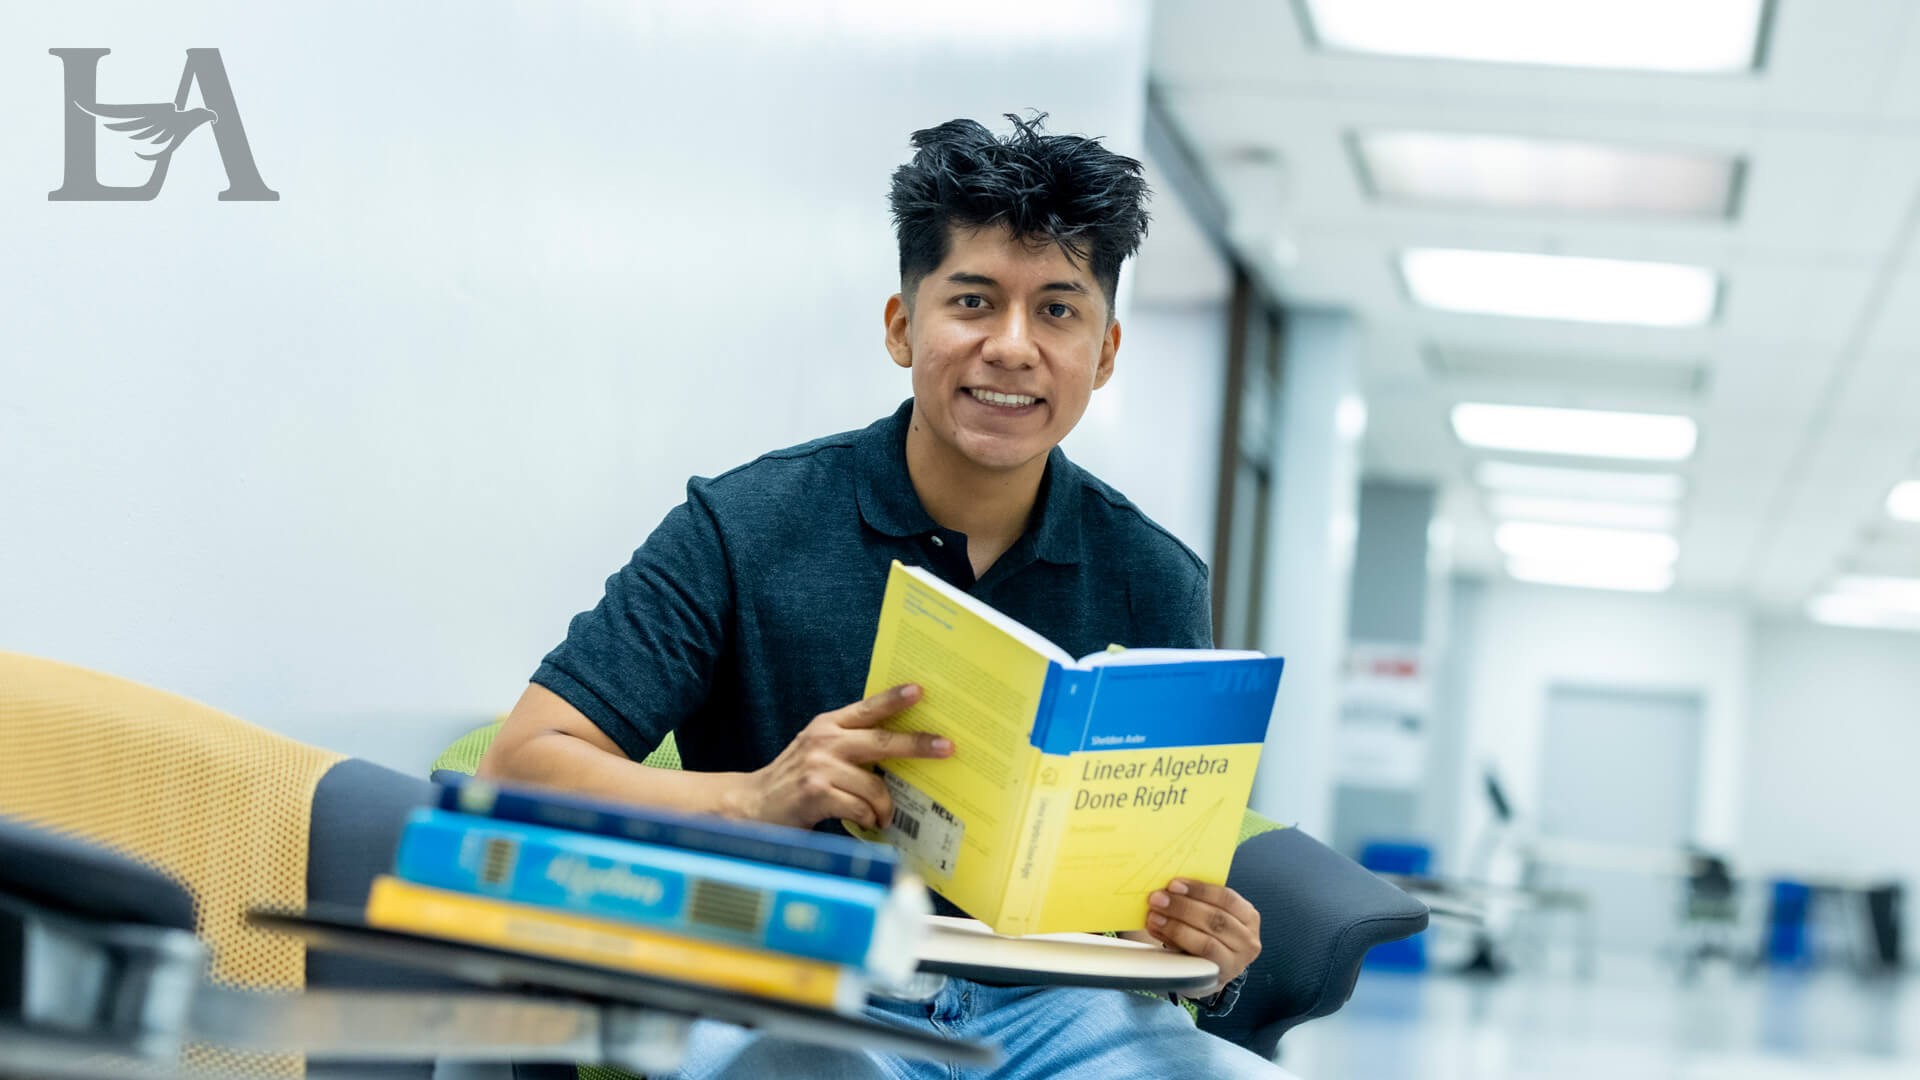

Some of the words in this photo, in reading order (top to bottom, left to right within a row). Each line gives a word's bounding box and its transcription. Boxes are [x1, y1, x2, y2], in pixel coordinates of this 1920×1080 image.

[1081, 759, 1147, 782] Linear
[1150, 753, 1229, 783] Algebra
[1073, 788, 1128, 811] Done
[1132, 784, 1188, 812] Right
